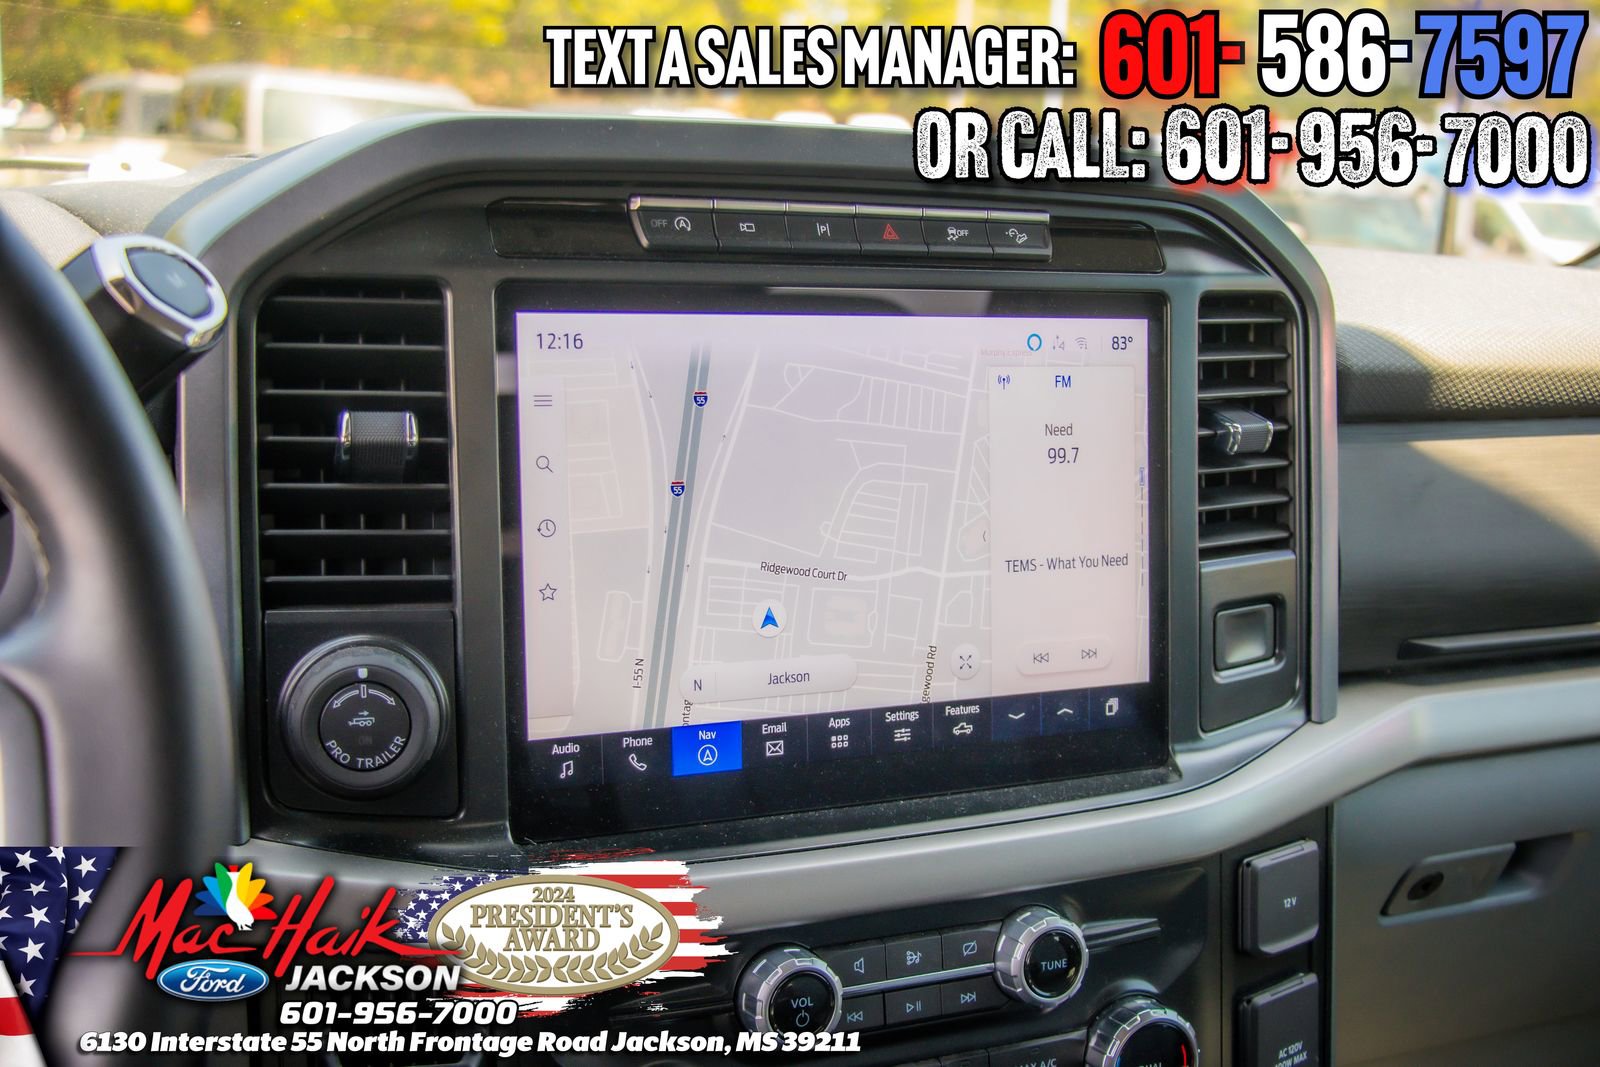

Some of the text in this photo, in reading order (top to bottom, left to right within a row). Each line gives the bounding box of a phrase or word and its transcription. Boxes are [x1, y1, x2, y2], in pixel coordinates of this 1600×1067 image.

[650, 219, 668, 228] OFF
[957, 229, 969, 237] OFF
[536, 333, 584, 350] 12:16
[1112, 336, 1134, 350] 83°
[1055, 375, 1072, 388] FM
[1044, 423, 1073, 437] Need
[1047, 447, 1080, 464] 99.7
[1005, 558, 1037, 573] TEMS
[1046, 556, 1076, 570] What
[1079, 555, 1099, 568] You
[1101, 553, 1129, 567] Need
[760, 561, 848, 582] Ridgewood Court Dr
[927, 645, 937, 660] Rd
[632, 658, 645, 689] I-55 N
[767, 671, 810, 686] Jackson
[693, 679, 702, 691] N
[885, 710, 919, 724] Settings
[945, 703, 980, 717] Features
[762, 722, 787, 734] Email
[828, 716, 850, 729] Apps
[623, 736, 653, 748] Phone
[698, 730, 716, 740] Nav
[325, 735, 406, 768] PRO TRAILER
[552, 742, 580, 755] Audio
[1040, 958, 1068, 971] TUNE
[791, 997, 814, 1008] VOL
[1279, 1040, 1304, 1059] AC 120V
[1293, 1051, 1307, 1064] MAX
